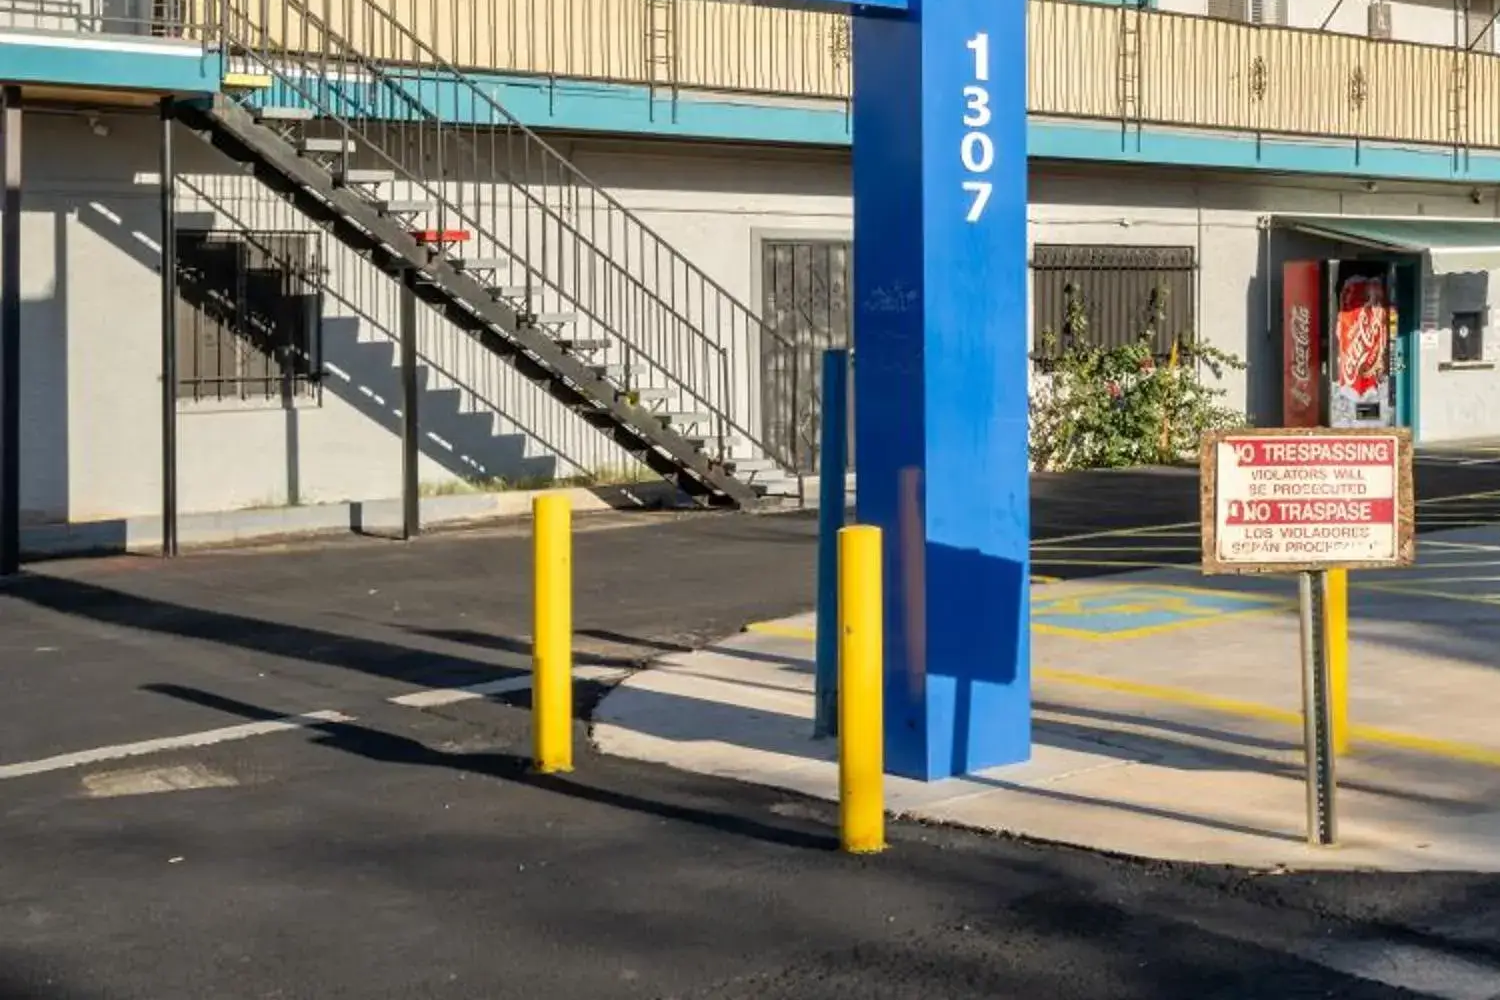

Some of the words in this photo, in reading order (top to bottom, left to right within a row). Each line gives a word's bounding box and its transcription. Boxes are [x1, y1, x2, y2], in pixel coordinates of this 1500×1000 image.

[960, 32, 994, 222] 1307
[1263, 443, 1389, 462] TRESPASSING
[1251, 469, 1327, 481] VIOLATORS
[1334, 469, 1365, 480] WILL
[1249, 484, 1267, 497] BE
[1274, 483, 1367, 495] PROSECUTED
[1243, 502, 1271, 521] NO
[1278, 502, 1372, 521] TRASPASE
[1245, 527, 1273, 539] LOS
[1280, 527, 1370, 539] VIOLADORES
